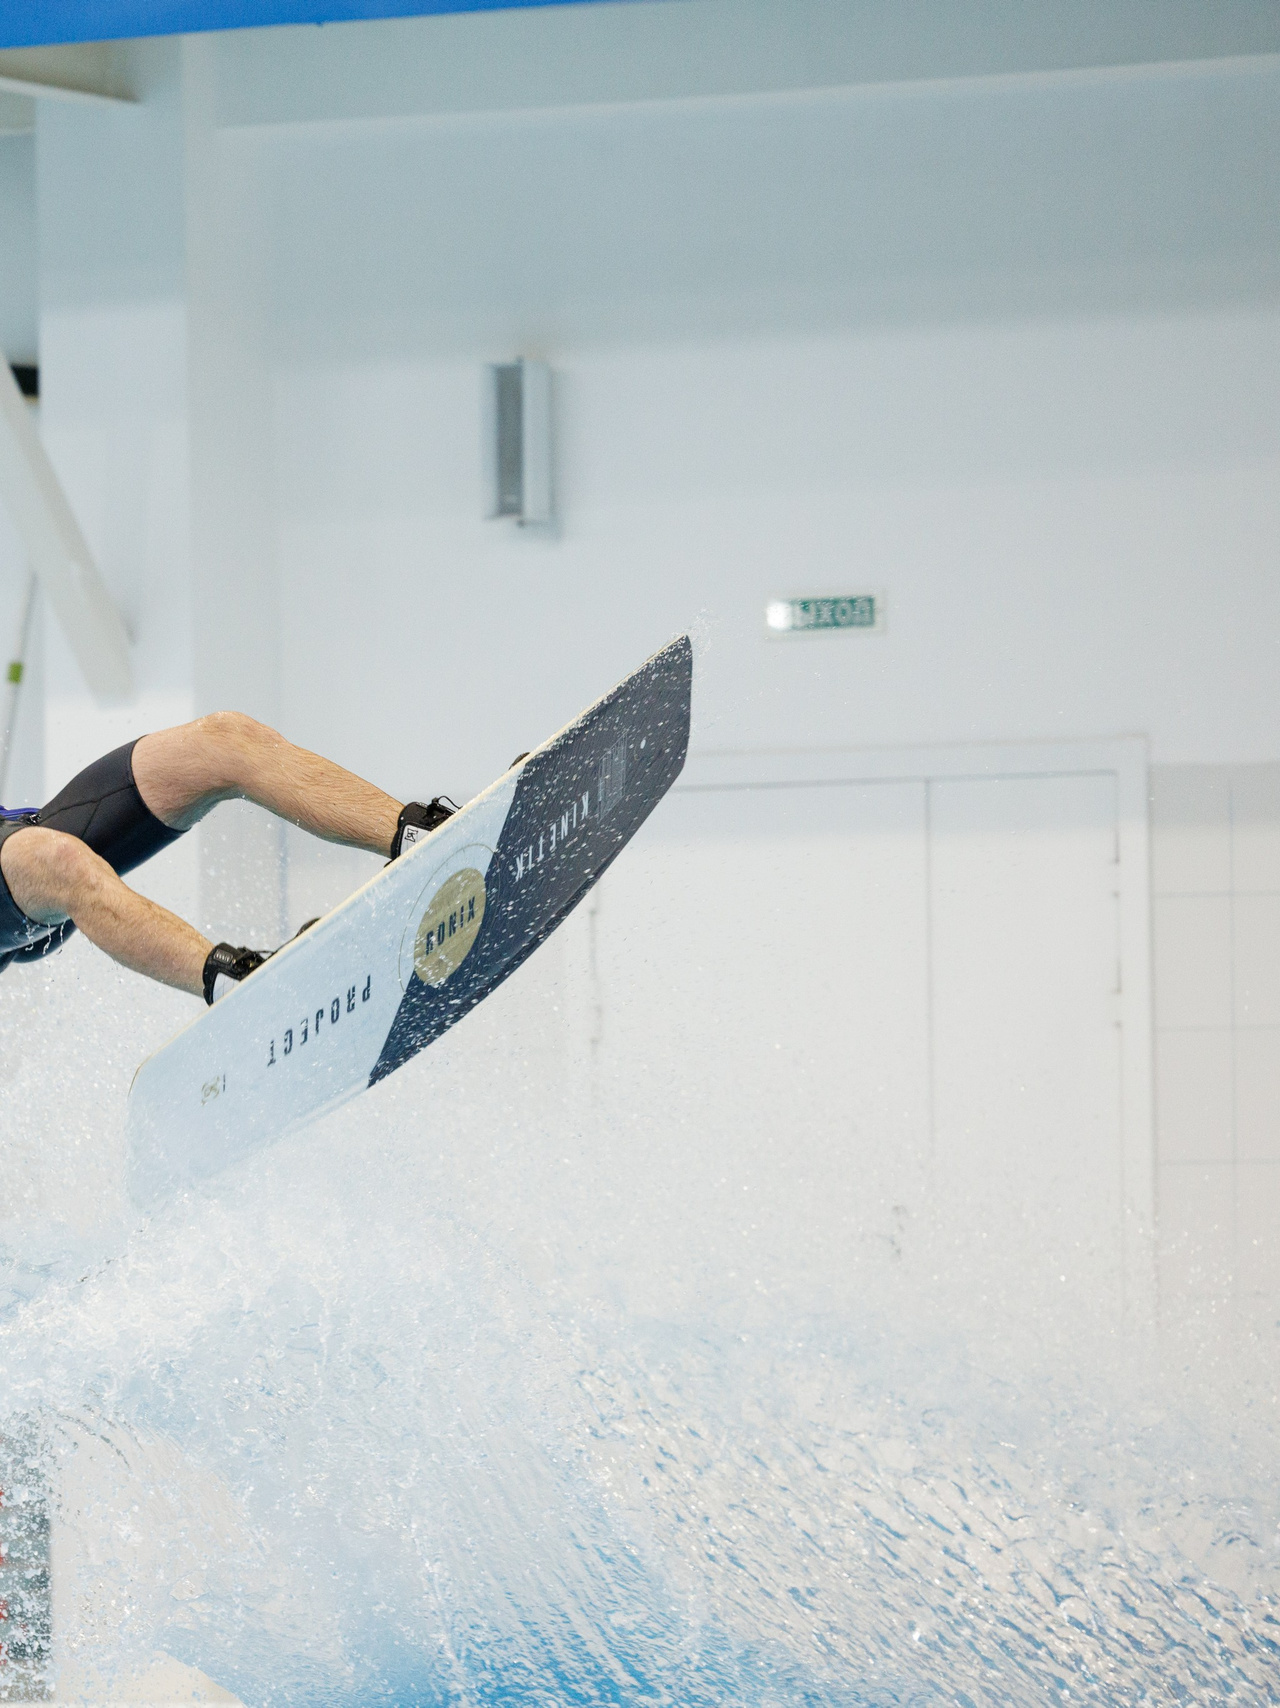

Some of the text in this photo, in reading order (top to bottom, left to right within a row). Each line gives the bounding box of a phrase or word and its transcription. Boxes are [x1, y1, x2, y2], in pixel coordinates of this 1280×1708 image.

[767, 600, 872, 628] ЫХОД
[515, 790, 589, 882] KINETIK
[425, 895, 477, 956] RONIX
[267, 974, 372, 1067] PROJECT
